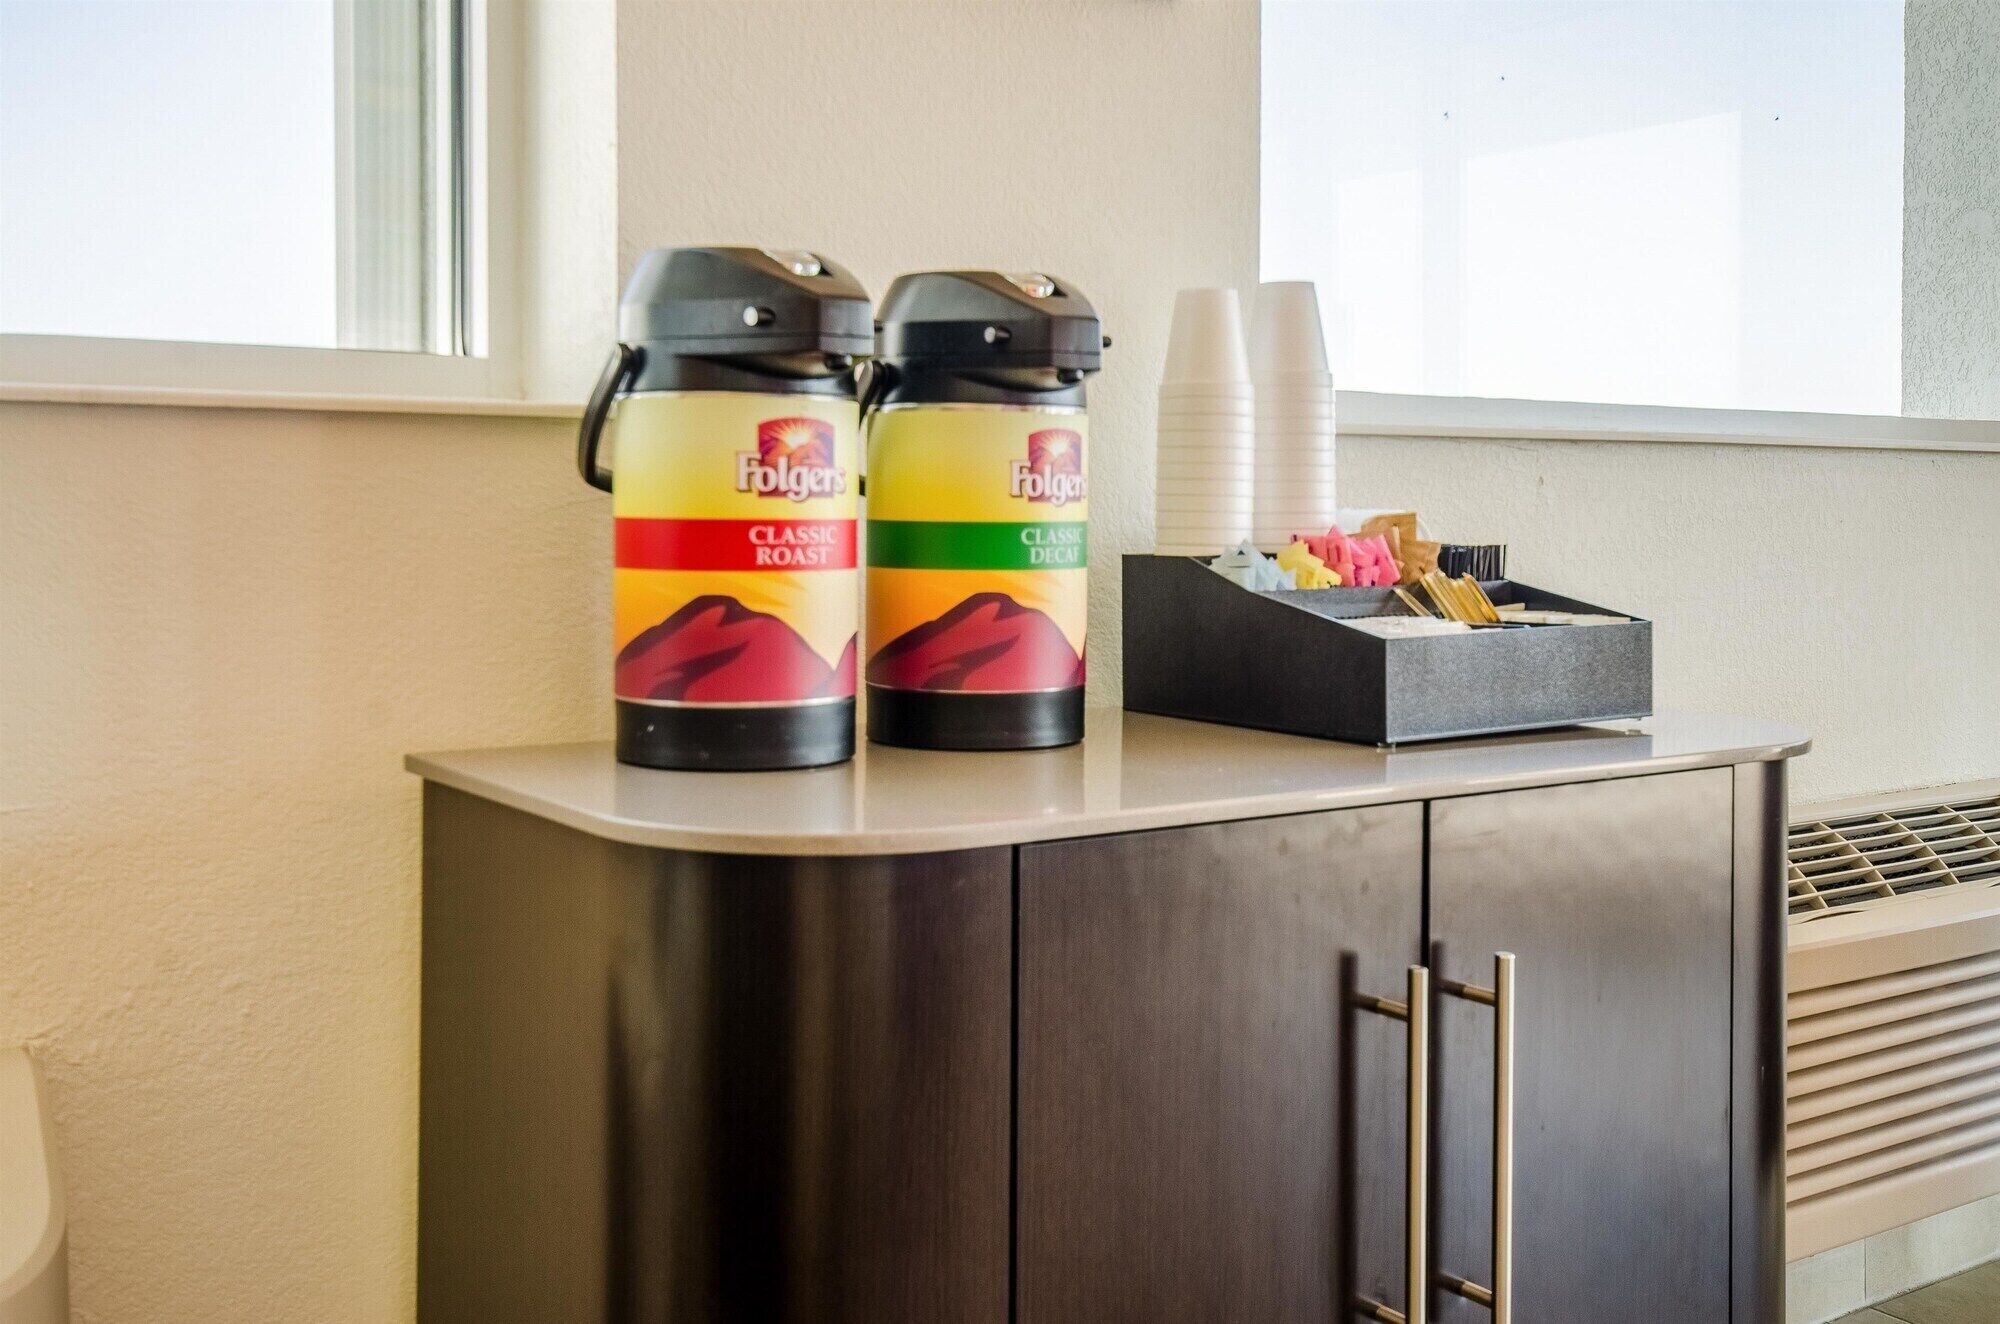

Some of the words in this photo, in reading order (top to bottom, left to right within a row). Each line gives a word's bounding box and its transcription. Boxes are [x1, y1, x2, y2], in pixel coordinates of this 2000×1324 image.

[736, 451, 847, 503] Folgers
[748, 525, 838, 545] CLASSIC
[1020, 527, 1083, 545] CLASSIC
[756, 546, 833, 565] ROAST
[1029, 546, 1079, 564] DECAF
